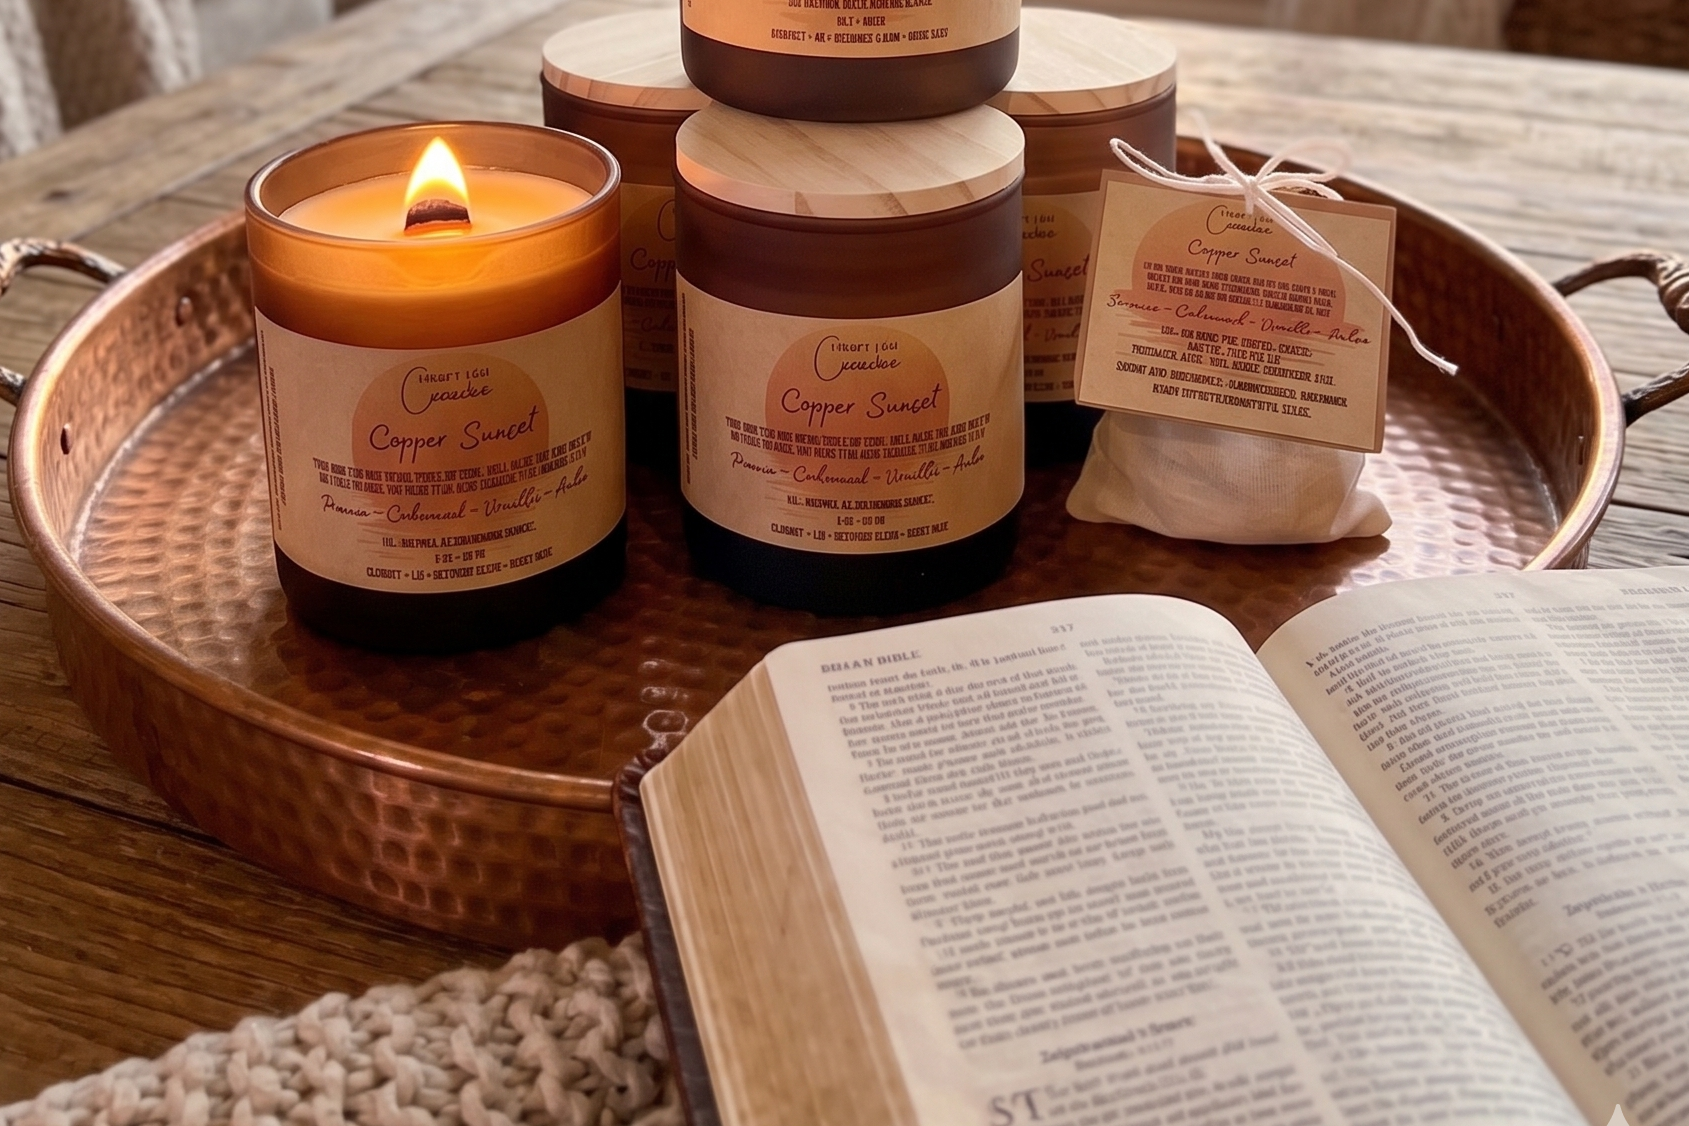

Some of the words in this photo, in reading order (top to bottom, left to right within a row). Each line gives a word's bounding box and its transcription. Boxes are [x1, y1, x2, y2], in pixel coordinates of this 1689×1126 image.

[630, 247, 676, 282] Copp
[781, 387, 855, 427] Copper
[369, 424, 447, 464] Copper
